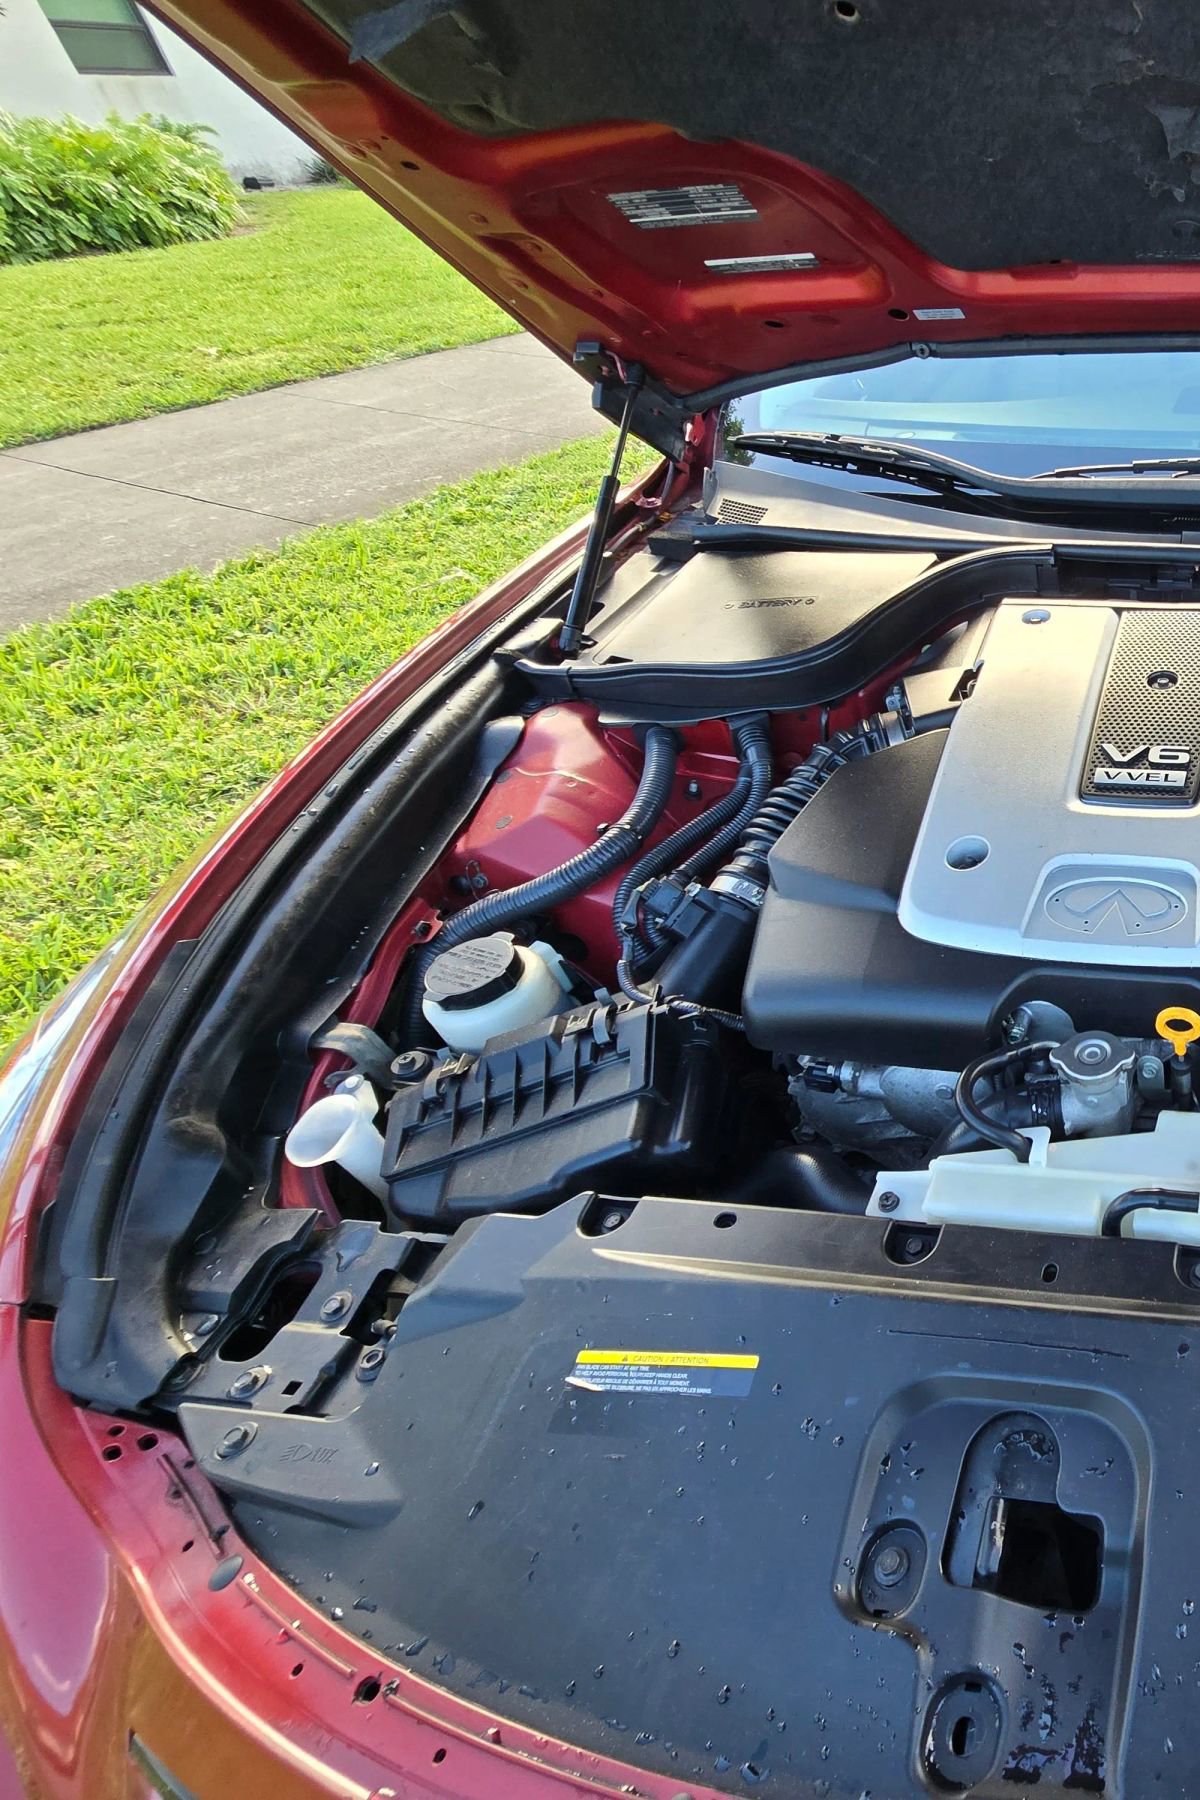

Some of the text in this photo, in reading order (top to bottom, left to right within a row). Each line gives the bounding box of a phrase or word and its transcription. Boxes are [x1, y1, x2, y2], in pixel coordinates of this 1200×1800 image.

[738, 598, 802, 609] BATTERY
[1100, 743, 1191, 766] V6
[1104, 771, 1178, 783] VVEL
[633, 1355, 663, 1363] CAUTION
[670, 1356, 710, 1364] ATTENTION
